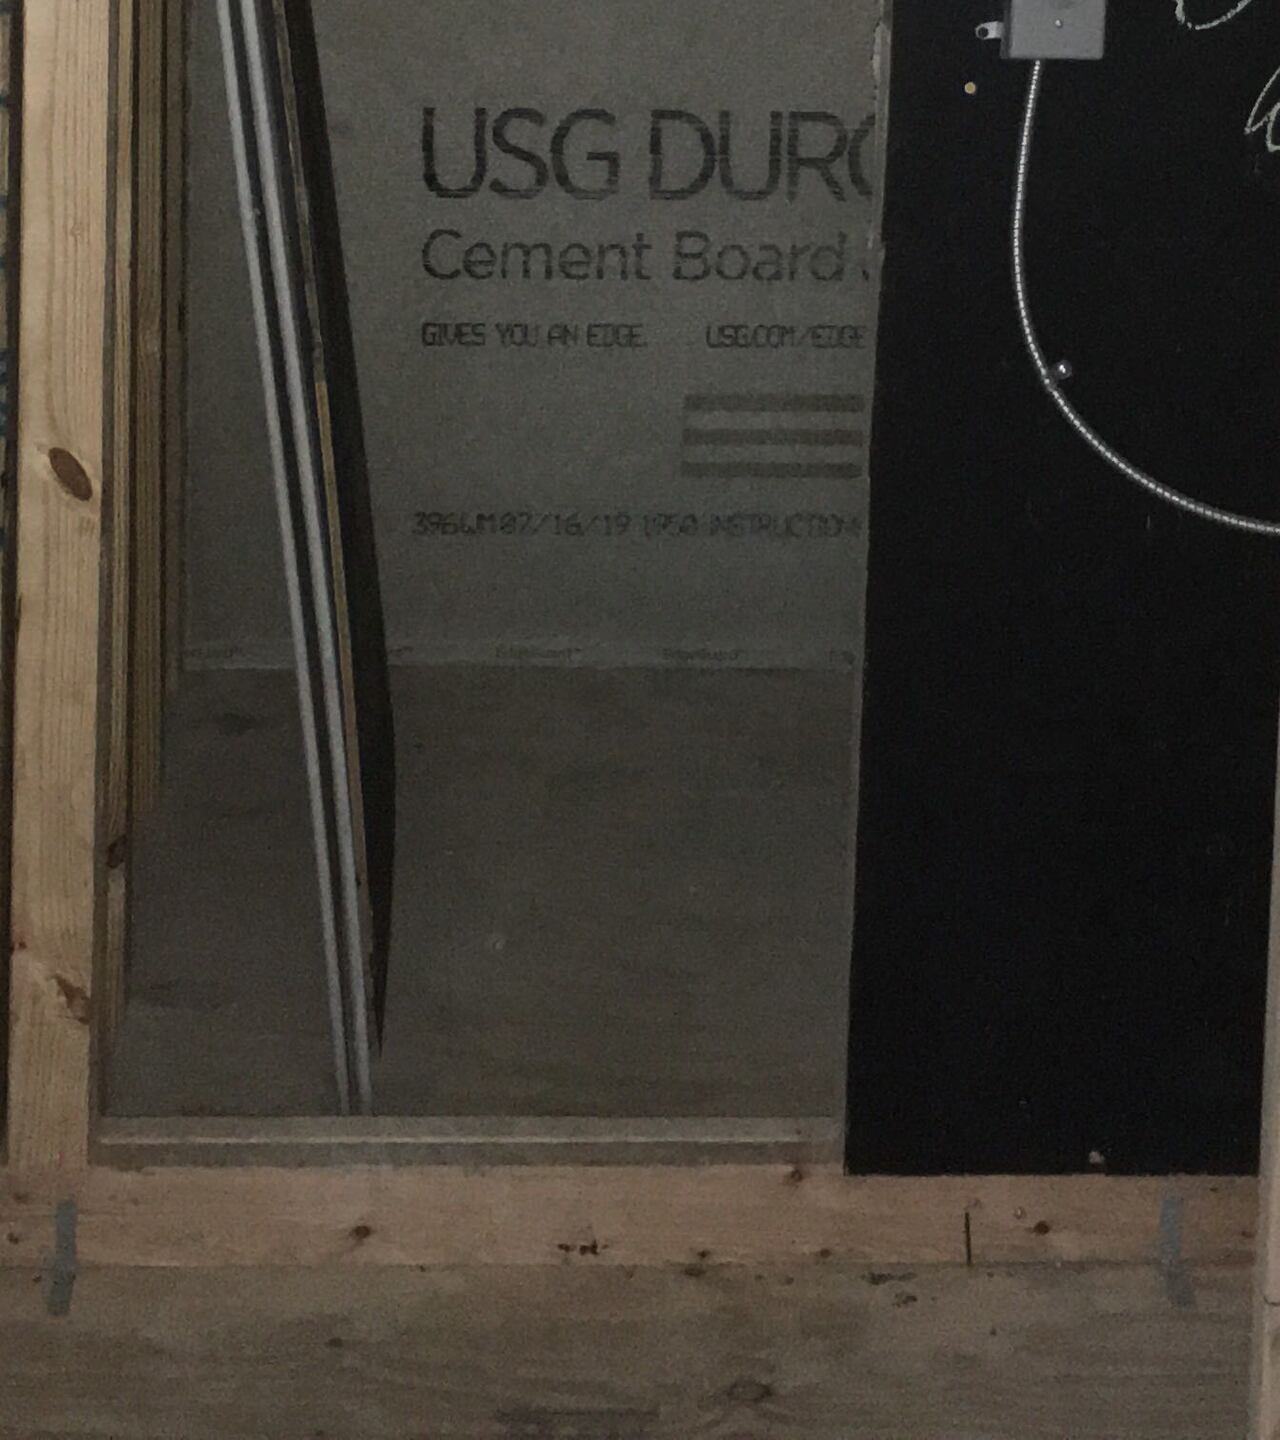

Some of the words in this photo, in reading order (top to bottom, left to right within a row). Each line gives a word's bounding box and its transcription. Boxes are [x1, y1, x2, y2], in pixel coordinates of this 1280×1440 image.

[421, 105, 621, 202] USG
[421, 229, 653, 282] Cement
[673, 230, 848, 283] Board
[421, 323, 486, 348] GIVES
[496, 323, 538, 347] YOU
[548, 324, 579, 346] AN
